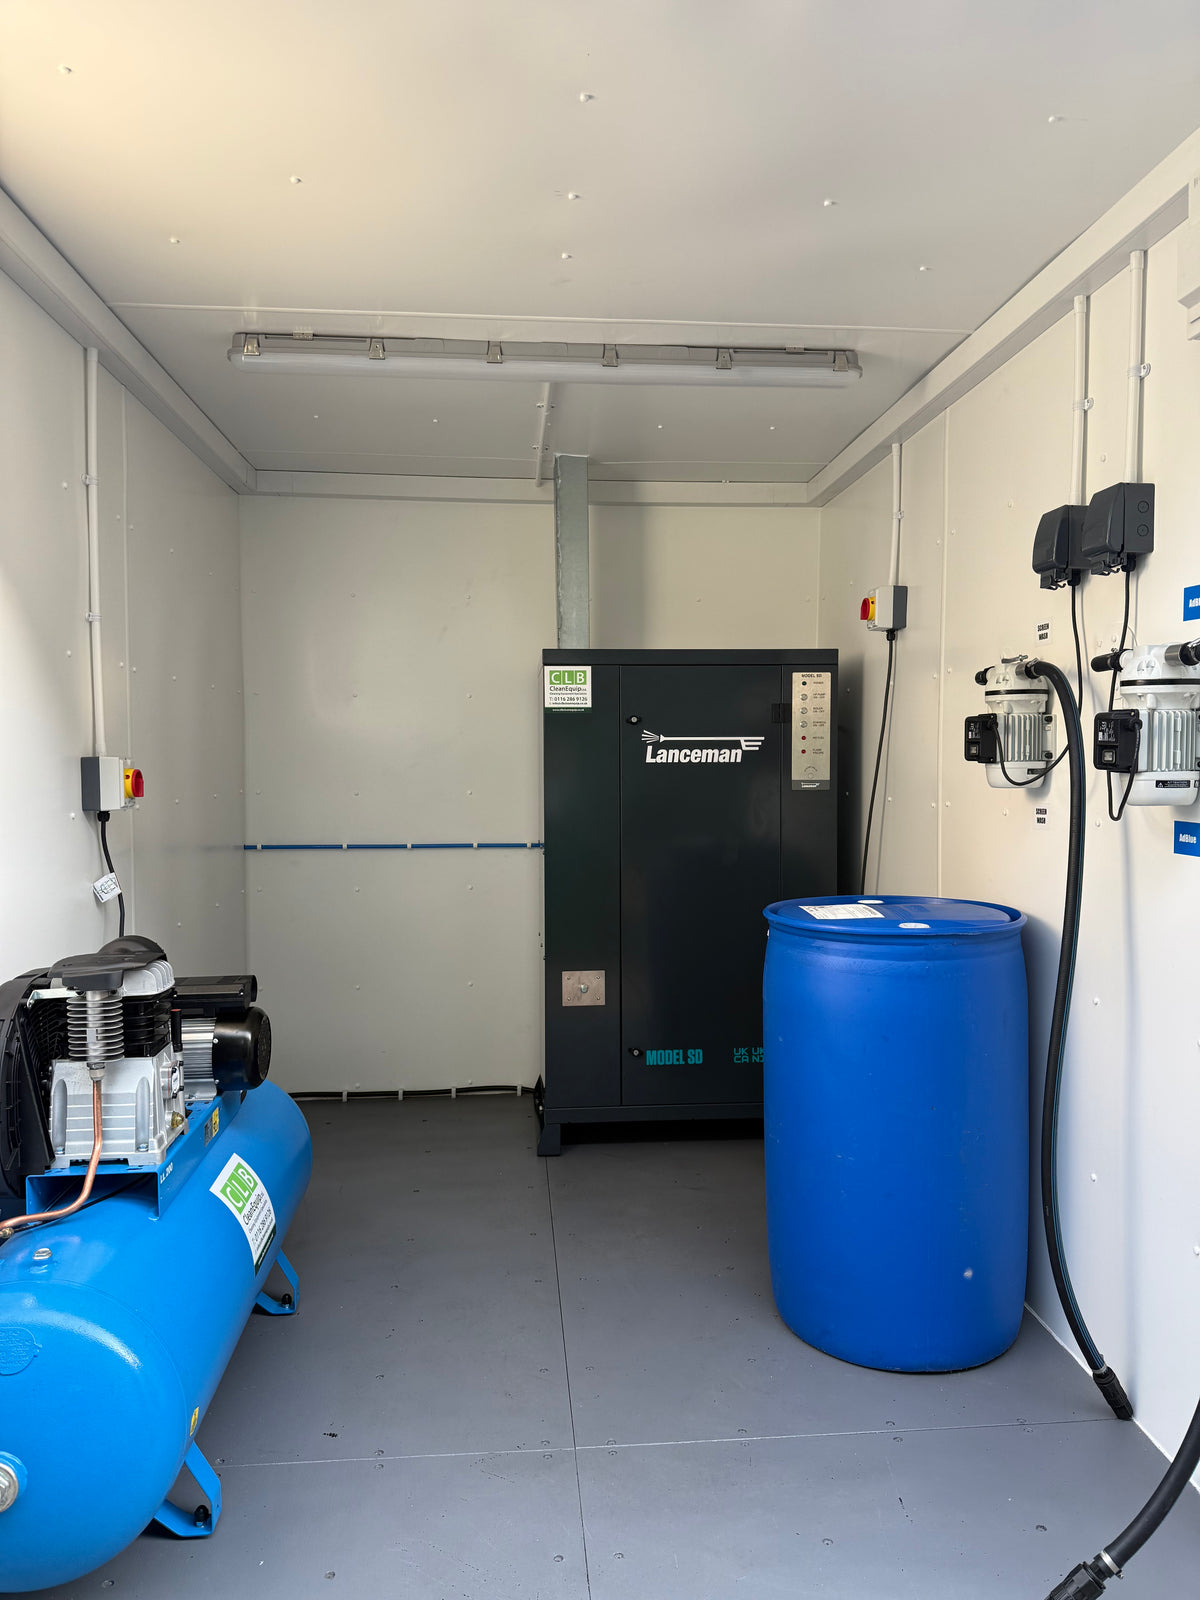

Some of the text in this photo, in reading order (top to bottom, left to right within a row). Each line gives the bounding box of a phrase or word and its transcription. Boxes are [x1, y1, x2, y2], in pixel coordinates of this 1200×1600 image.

[1037, 623, 1049, 632] SCREEN
[1039, 632, 1048, 640] WASH
[551, 672, 585, 684] CLB
[645, 745, 742, 763] Lanceman
[1179, 833, 1197, 844] AdBlue
[733, 1047, 748, 1055] UK
[646, 1049, 703, 1065] MODEL SD
[733, 1055, 749, 1063] CA
[226, 1168, 255, 1207] CLB
